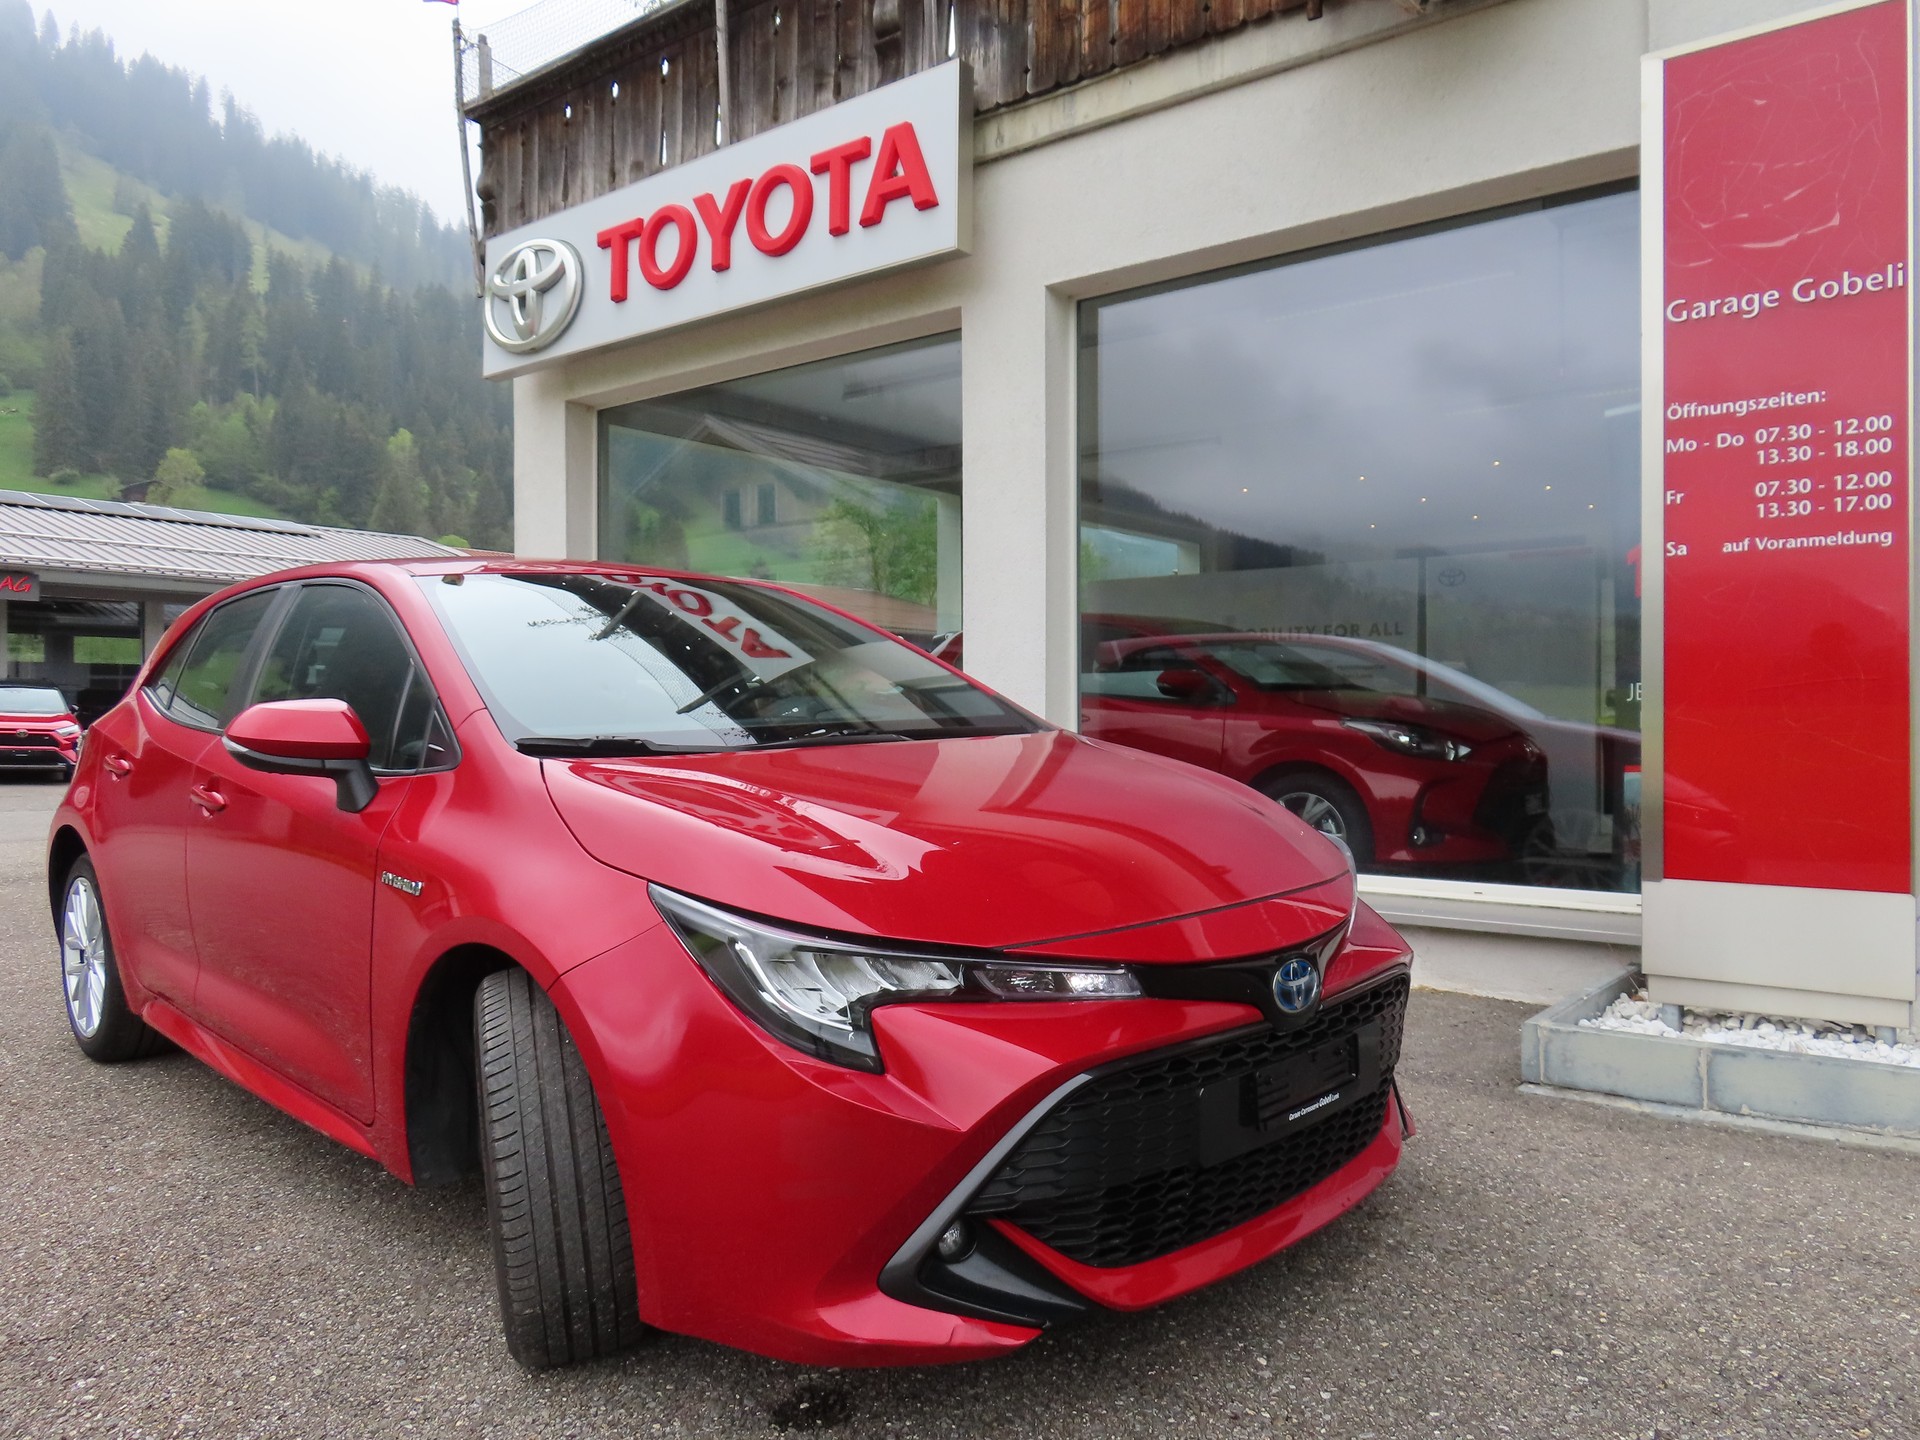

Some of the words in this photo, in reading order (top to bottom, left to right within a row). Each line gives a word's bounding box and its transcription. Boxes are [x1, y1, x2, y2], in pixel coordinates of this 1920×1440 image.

[597, 121, 939, 303] TOYOTA
[1666, 289, 1780, 323] Garage
[1792, 262, 1904, 303] Gobeli
[1667, 390, 1827, 420] Öffnungszeiten:
[1666, 438, 1698, 454] Mo
[1716, 433, 1745, 449] Do
[1755, 423, 1812, 445] 07.30
[1834, 414, 1893, 436] 12.00
[1756, 445, 1812, 466] 13.30
[1834, 437, 1893, 458] 18.00
[1666, 490, 1685, 505] Fr
[1755, 478, 1812, 498] 07.30
[1834, 470, 1893, 491] 12.00
[1756, 499, 1812, 519] 13.30
[1834, 493, 1893, 513] 17.00
[1666, 541, 1688, 557] Sa
[1722, 537, 1751, 553] auf
[1755, 530, 1893, 551] Voranmeldung
[0, 575, 33, 593] AG
[1323, 623, 1360, 638] FOR
[1369, 621, 1404, 637] ALL
